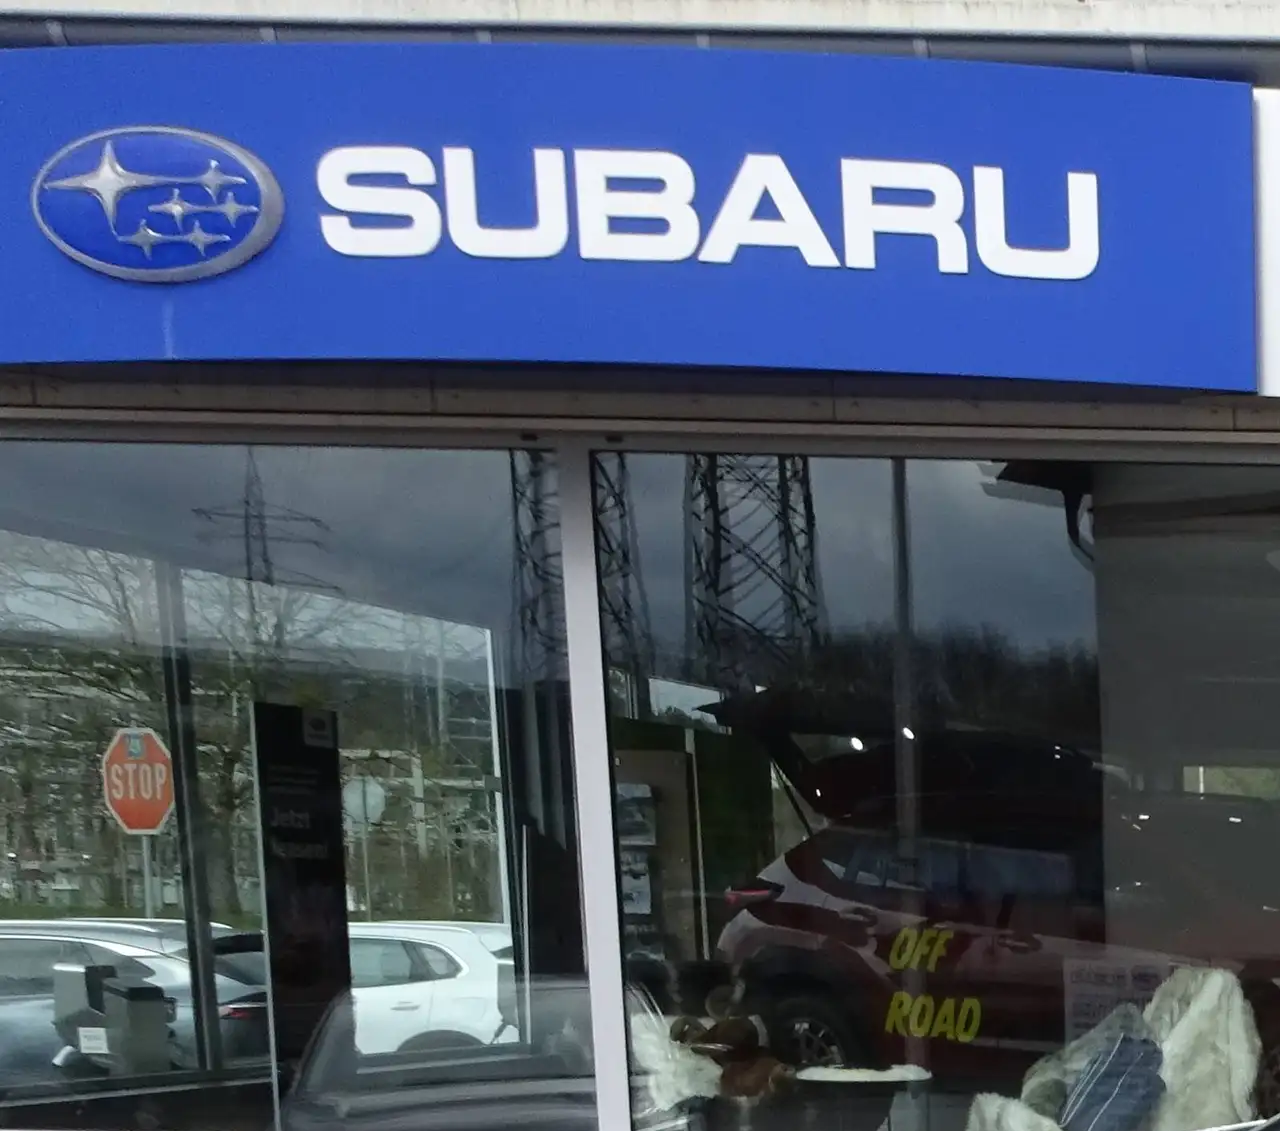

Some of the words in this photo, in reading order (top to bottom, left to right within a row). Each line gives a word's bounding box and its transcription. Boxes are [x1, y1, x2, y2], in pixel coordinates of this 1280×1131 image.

[317, 145, 1101, 281] SUBARU
[111, 763, 167, 800] STOP
[889, 927, 954, 973] OFF
[884, 991, 981, 1042] ROAD
